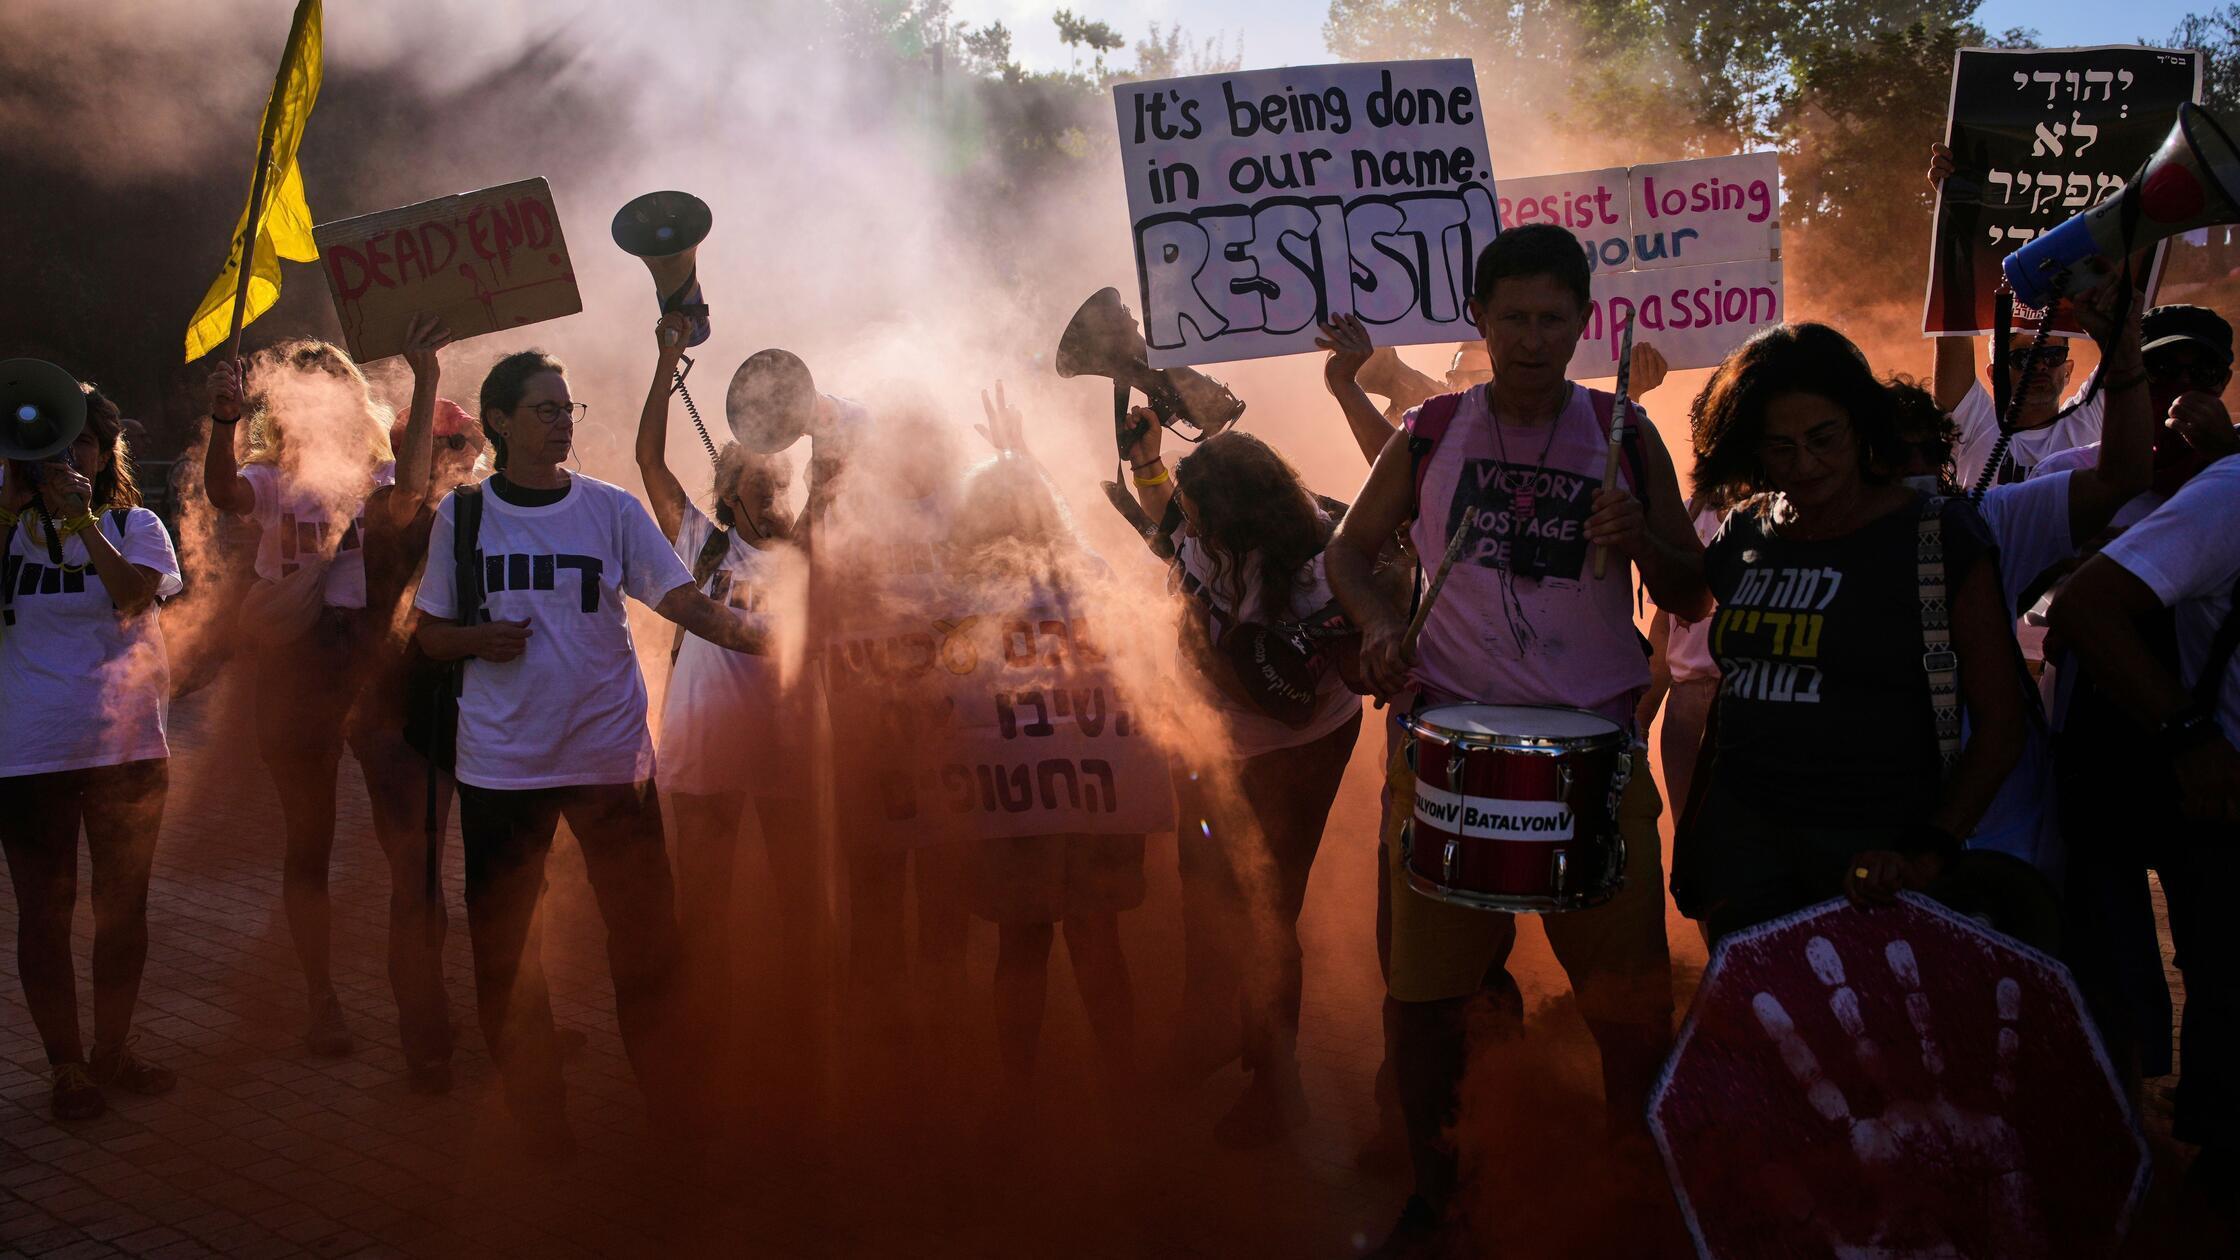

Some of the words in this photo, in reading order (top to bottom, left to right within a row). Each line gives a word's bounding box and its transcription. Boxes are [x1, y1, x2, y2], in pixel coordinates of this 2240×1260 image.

[1134, 89, 1202, 144] It's
[1222, 80, 1352, 137] being
[1366, 70, 1474, 128] done
[2031, 110, 2098, 158] לא
[1148, 159, 1200, 204] in
[1228, 147, 1332, 193] our
[1351, 146, 1489, 188] name.
[1644, 177, 1772, 223] losing
[328, 221, 457, 301] DEAD
[467, 196, 554, 264] END
[1134, 181, 1501, 350] RESIST!
[1583, 280, 1777, 361] mpassion
[1476, 463, 1584, 503] VICTORY
[1475, 537, 1546, 568] DEL
[1730, 568, 1774, 606] הם
[1768, 566, 1843, 610] למה
[1715, 609, 1825, 658] עדיין
